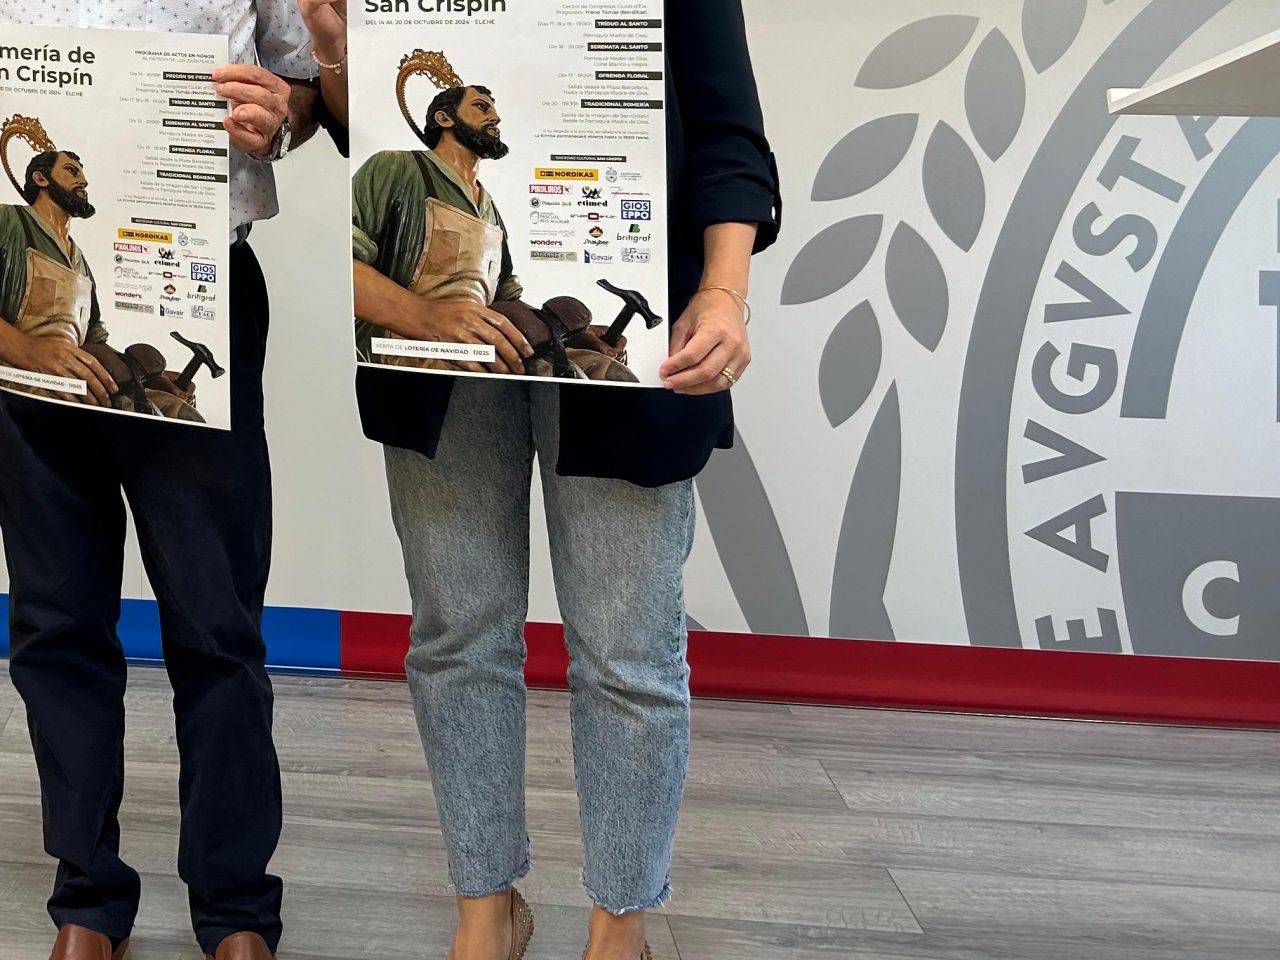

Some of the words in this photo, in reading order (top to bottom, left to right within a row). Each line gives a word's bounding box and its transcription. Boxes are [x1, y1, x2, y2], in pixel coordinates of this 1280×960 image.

[68, 46, 95, 64] de
[16, 65, 92, 87] Crispín
[623, 202, 649, 210] GIOS
[623, 211, 649, 219] EPPO
[135, 232, 168, 240] NORDIKAS
[193, 265, 214, 273] GIOS
[192, 273, 214, 282] EPPO
[115, 291, 142, 299] wonders
